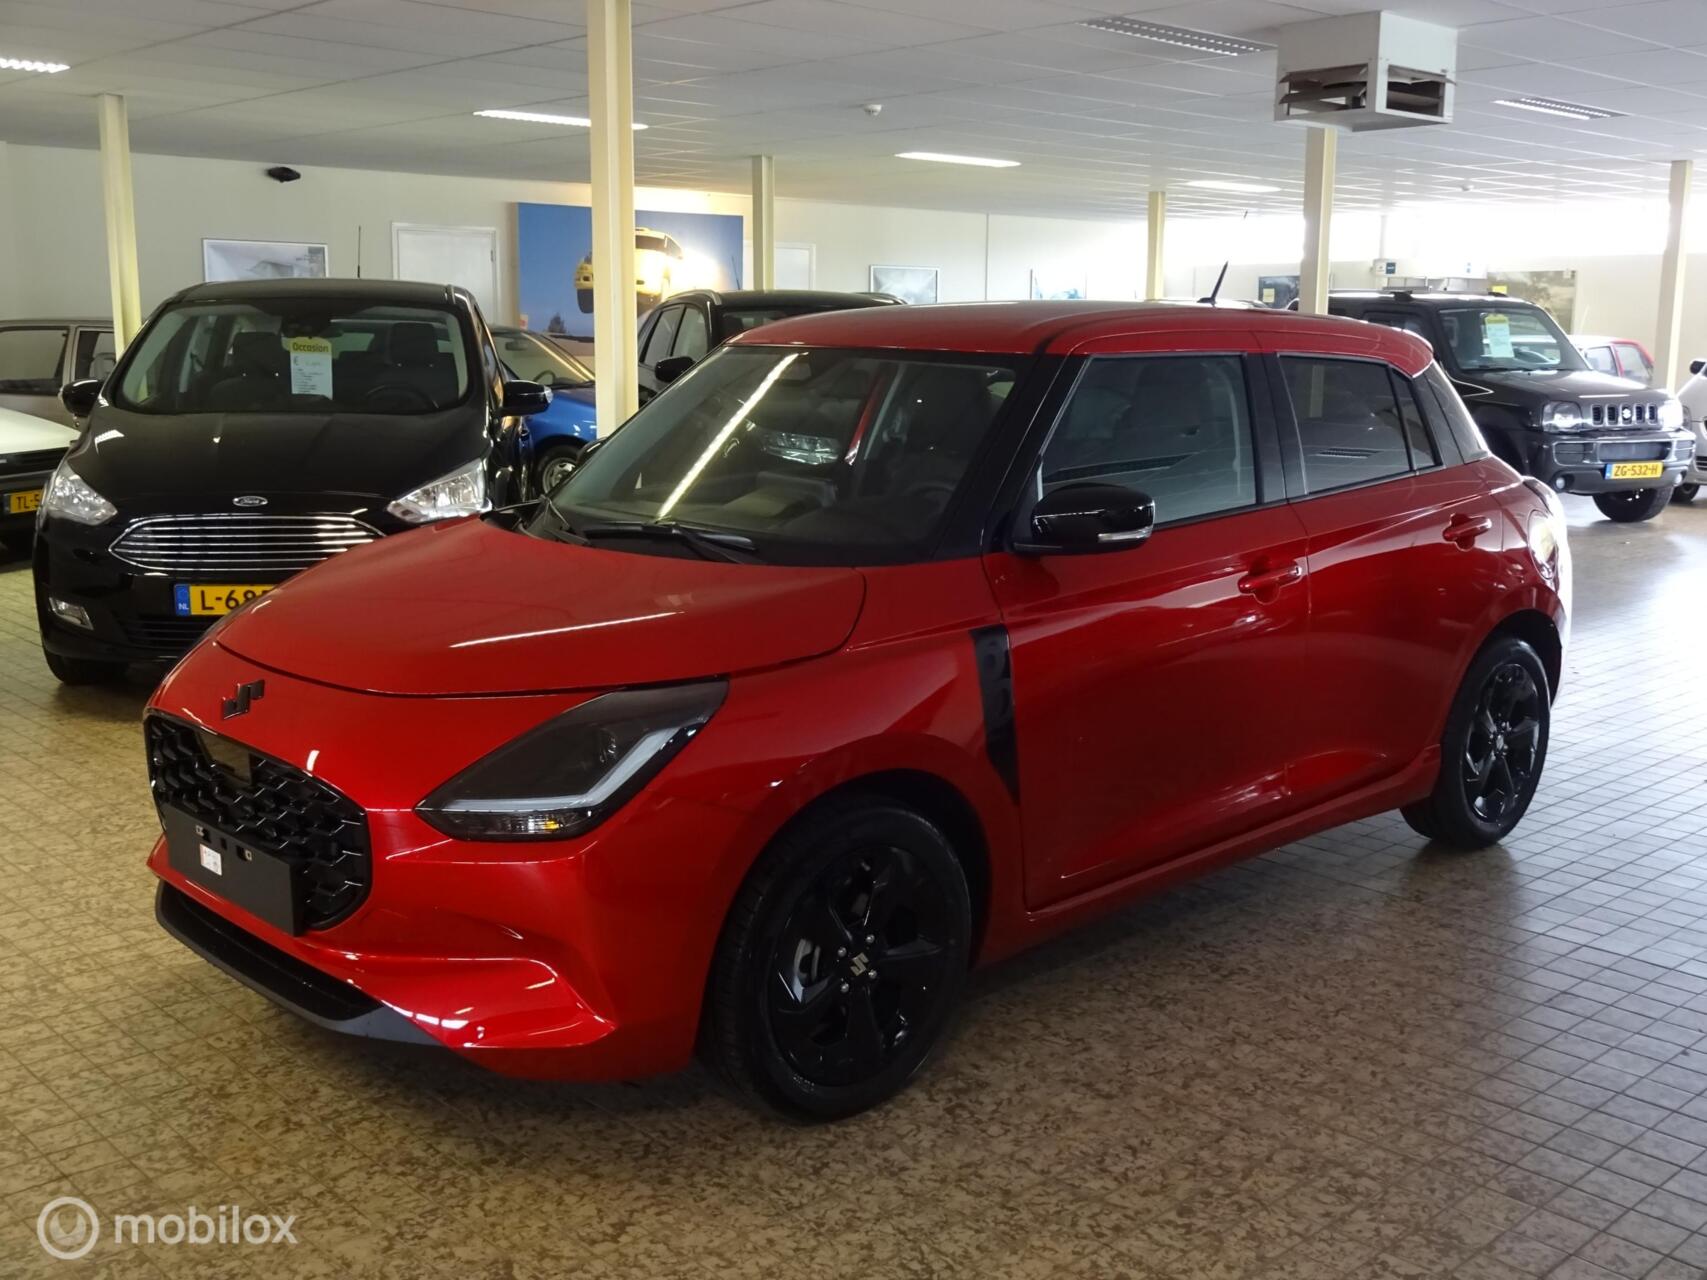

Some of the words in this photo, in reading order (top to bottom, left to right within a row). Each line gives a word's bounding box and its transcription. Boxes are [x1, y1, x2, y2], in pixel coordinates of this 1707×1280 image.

[292, 342, 329, 352] Occasion
[1614, 464, 1658, 477] ZG-532-H
[201, 590, 269, 610] L-68
